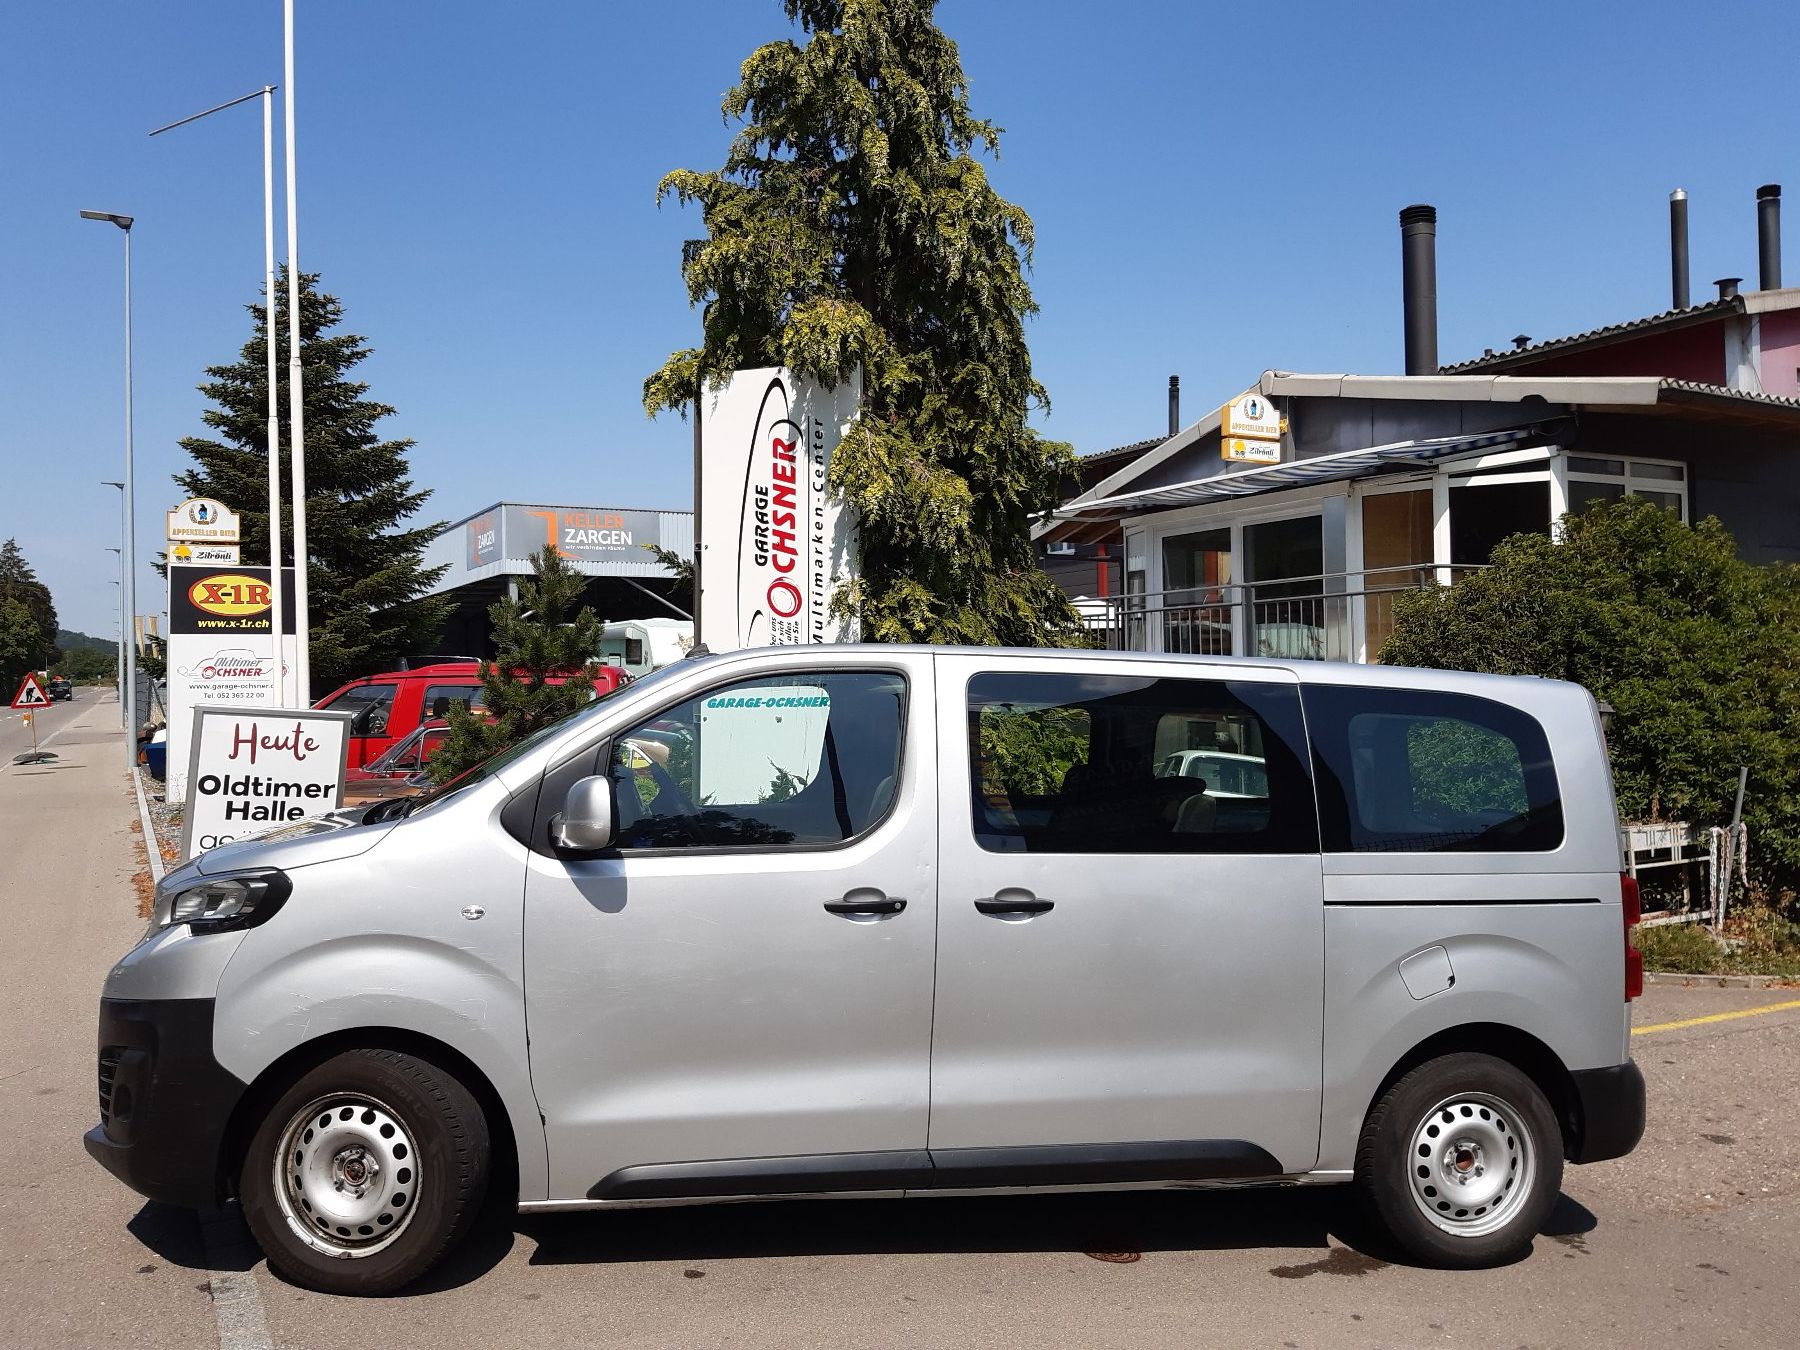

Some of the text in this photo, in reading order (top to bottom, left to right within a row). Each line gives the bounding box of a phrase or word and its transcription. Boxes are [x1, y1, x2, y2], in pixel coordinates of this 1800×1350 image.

[563, 511, 625, 529] KELLER
[755, 484, 769, 567] GARAGE
[767, 437, 803, 618] OCHSNER
[172, 529, 236, 537] APPENZELLER BIER
[565, 528, 633, 546] ZARGEN
[196, 551, 232, 560] Zitrönli
[199, 583, 272, 605] X-1R
[197, 619, 270, 629] www.x-1r.ch
[784, 622, 792, 641] alles
[214, 657, 263, 667] Oldtimer
[202, 666, 263, 680] OCHSNER
[228, 722, 320, 765] Heute
[198, 775, 336, 799] Oldtimer
[225, 800, 305, 822] Halle
